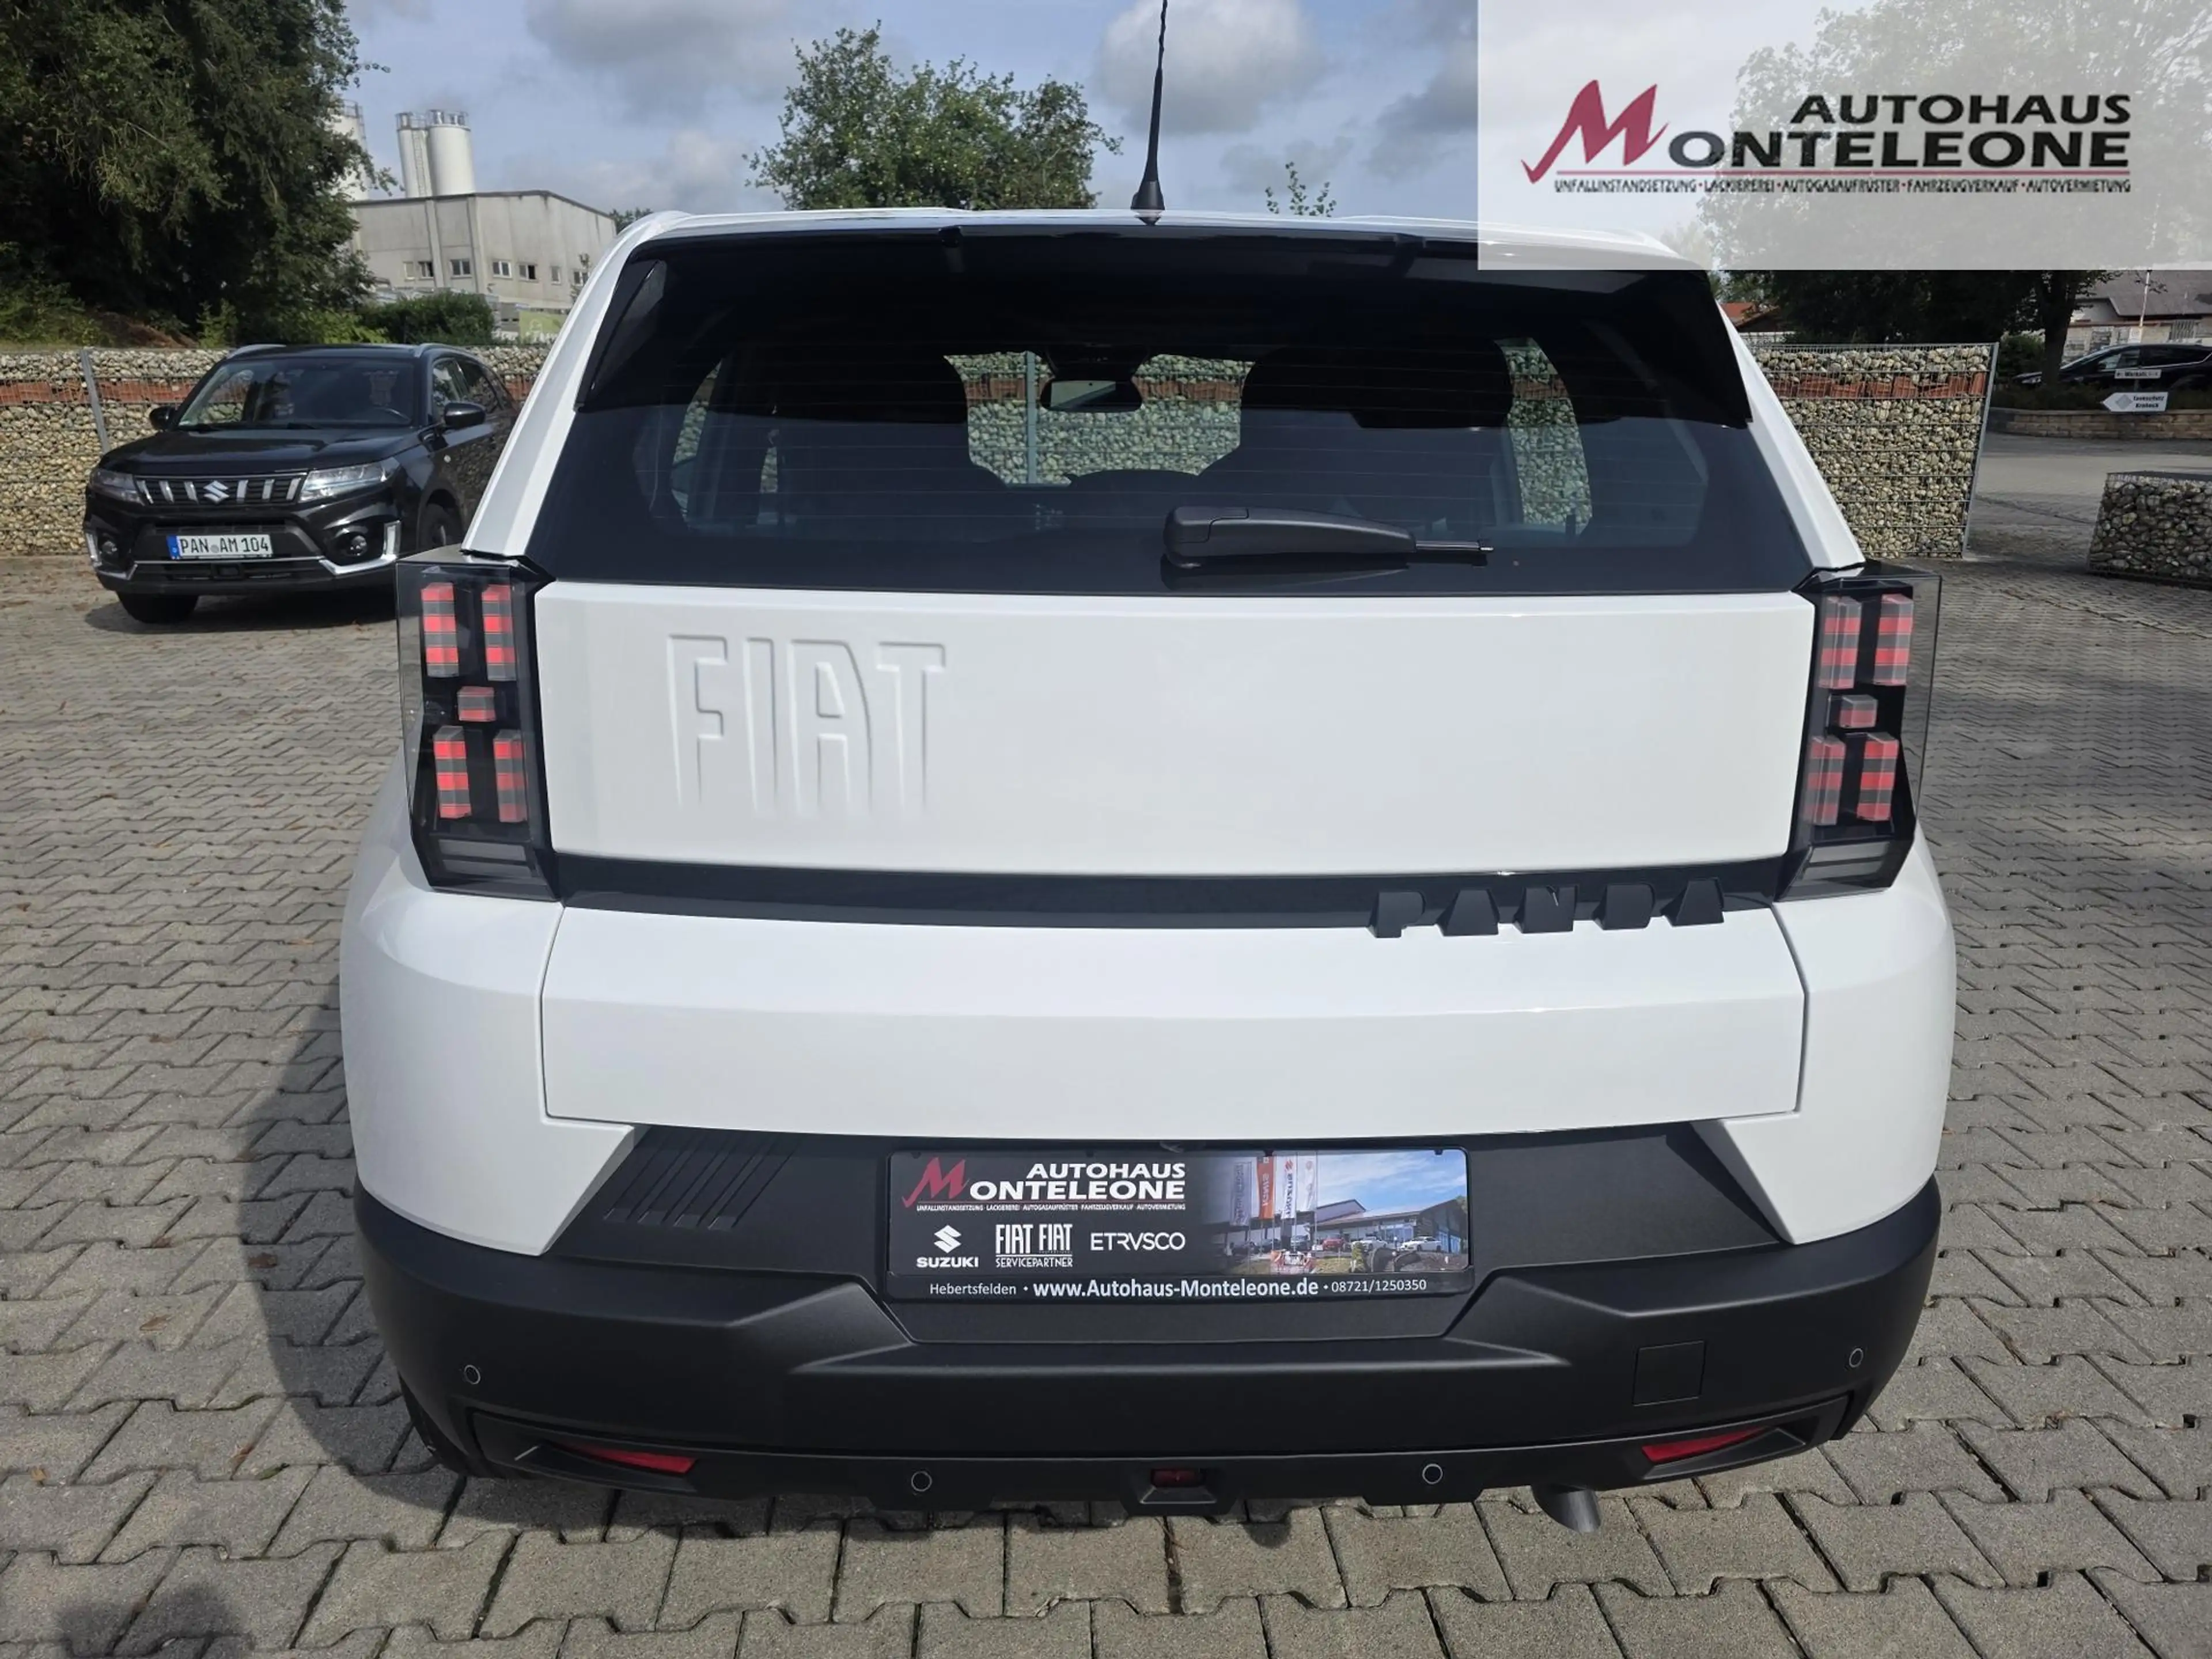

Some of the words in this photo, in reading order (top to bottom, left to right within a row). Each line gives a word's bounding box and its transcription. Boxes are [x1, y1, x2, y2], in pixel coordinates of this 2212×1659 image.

[180, 539, 210, 553] PAN
[219, 537, 238, 552] AM
[241, 536, 269, 552] 104
[666, 633, 946, 813] FIAT
[1365, 878, 1725, 938] PANDA
[1026, 1162, 1186, 1179] AUTOHAUS
[902, 1157, 1186, 1207] MONTELEONE
[995, 1224, 1034, 1254] FIAT
[1039, 1224, 1073, 1251] FIAT
[916, 1257, 979, 1268] SUZUKI
[995, 1257, 1073, 1268] SERVICEPARTNER
[930, 1283, 1017, 1295] Hebertsfelden
[1033, 1277, 1319, 1298] www.Autohaus-Monteleone.de
[1331, 1278, 1427, 1293] 08721/1250350
